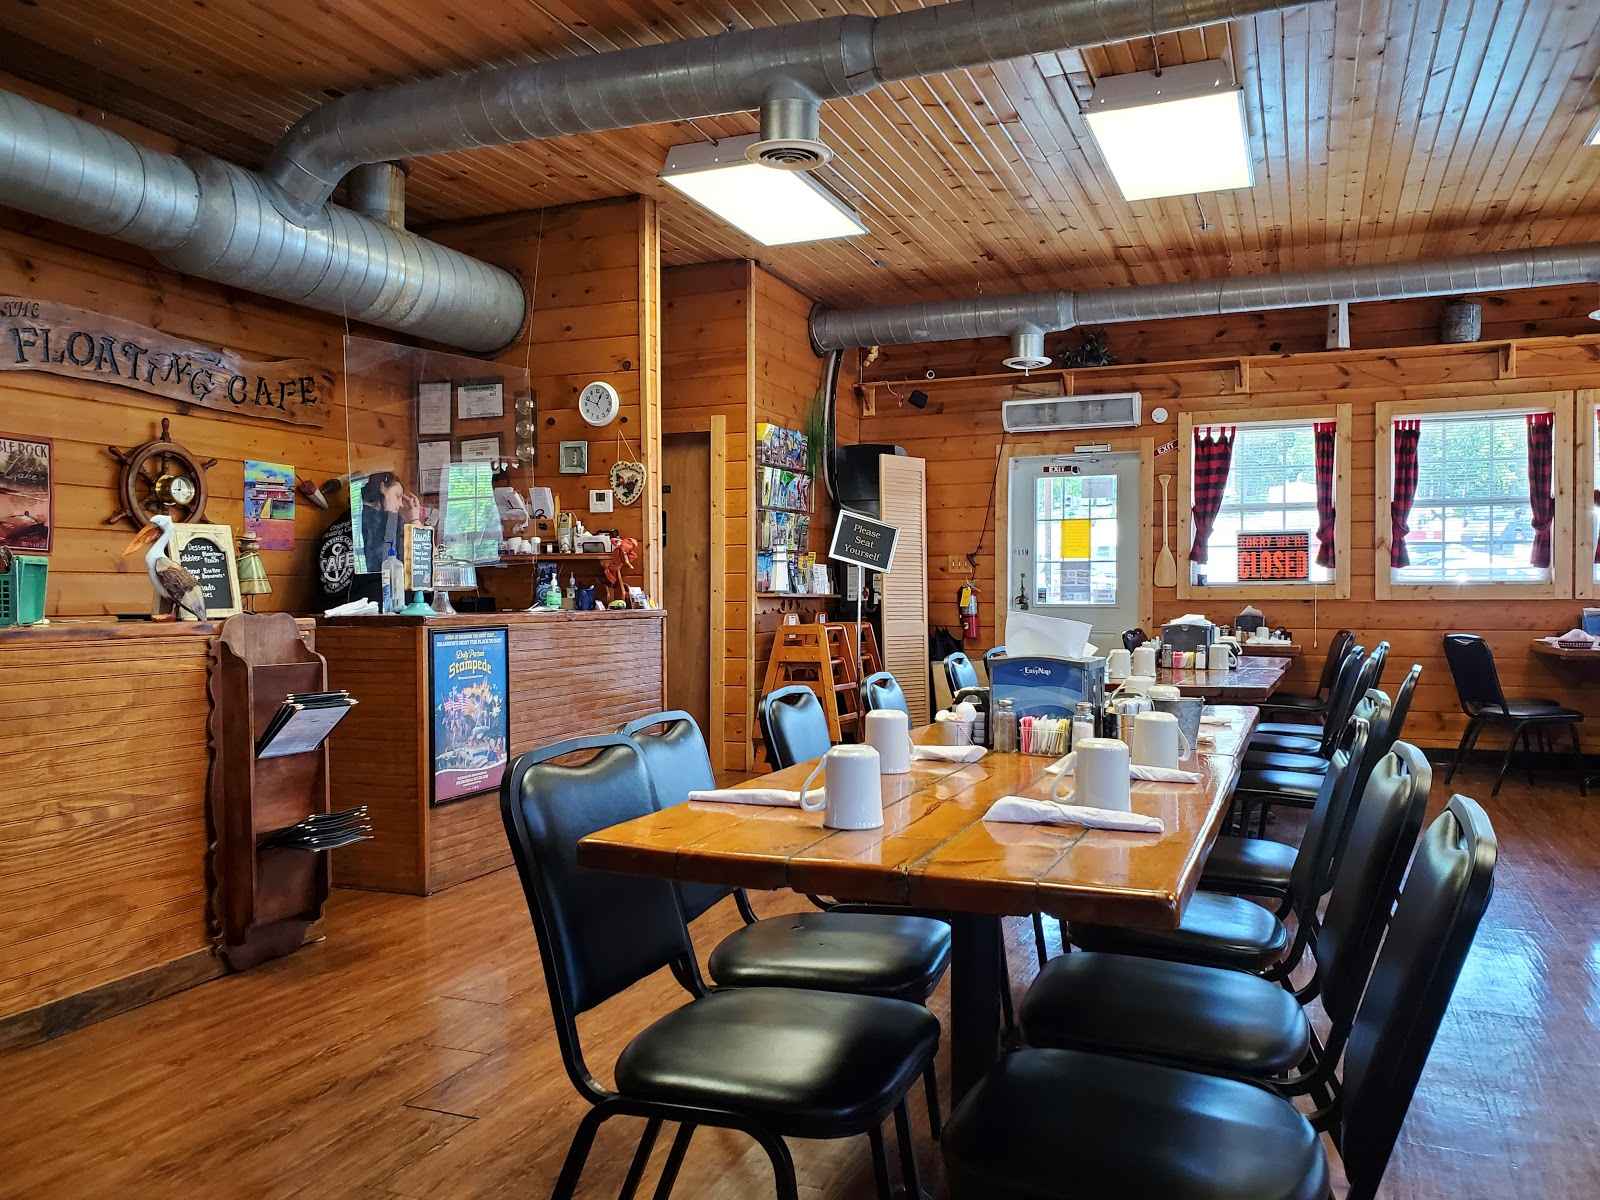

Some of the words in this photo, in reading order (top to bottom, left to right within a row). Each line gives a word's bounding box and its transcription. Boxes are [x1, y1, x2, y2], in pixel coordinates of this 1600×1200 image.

[5, 301, 41, 319] THE
[8, 327, 217, 402] FLOATING
[227, 374, 319, 411] CAFE
[18, 442, 48, 459] ROCK
[1158, 441, 1175, 455] EXIT
[853, 523, 881, 539] Please
[854, 536, 874, 548] Seat
[844, 543, 880, 561] Yourself
[448, 658, 492, 679] Stampede
